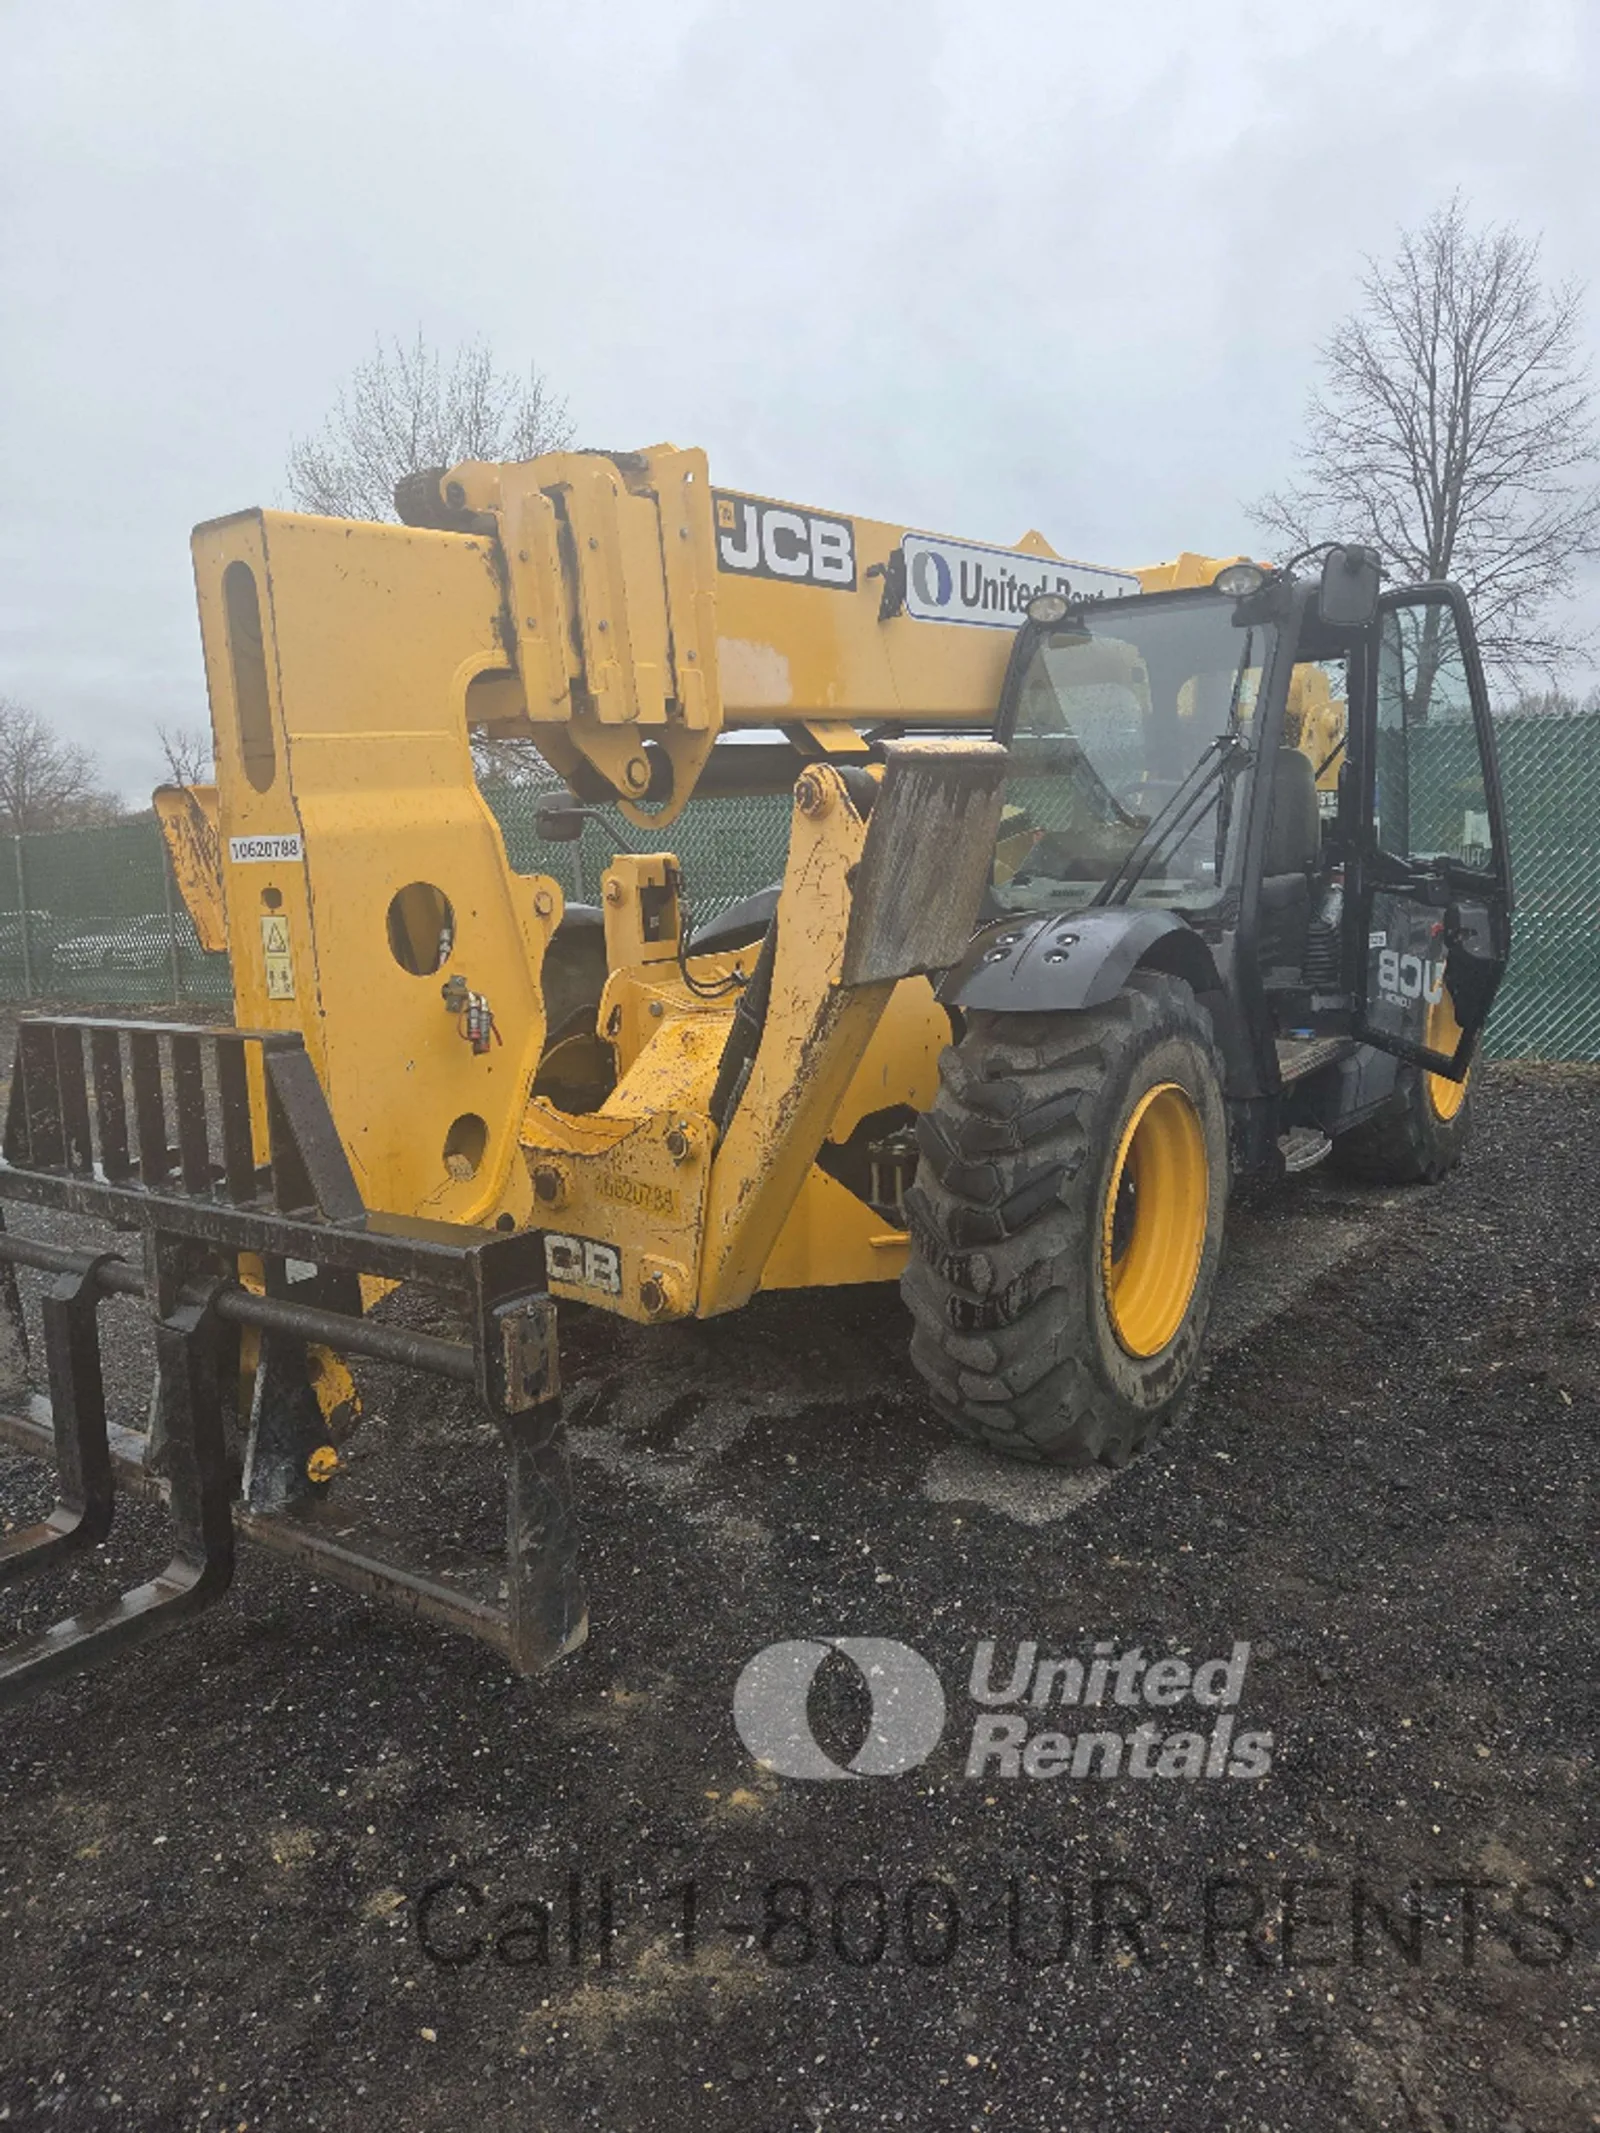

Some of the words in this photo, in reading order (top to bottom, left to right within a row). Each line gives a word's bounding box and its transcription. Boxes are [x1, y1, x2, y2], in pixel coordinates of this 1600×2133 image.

[720, 503, 853, 584] JCB
[231, 839, 299, 859] 10620788
[543, 1234, 623, 1295] CB
